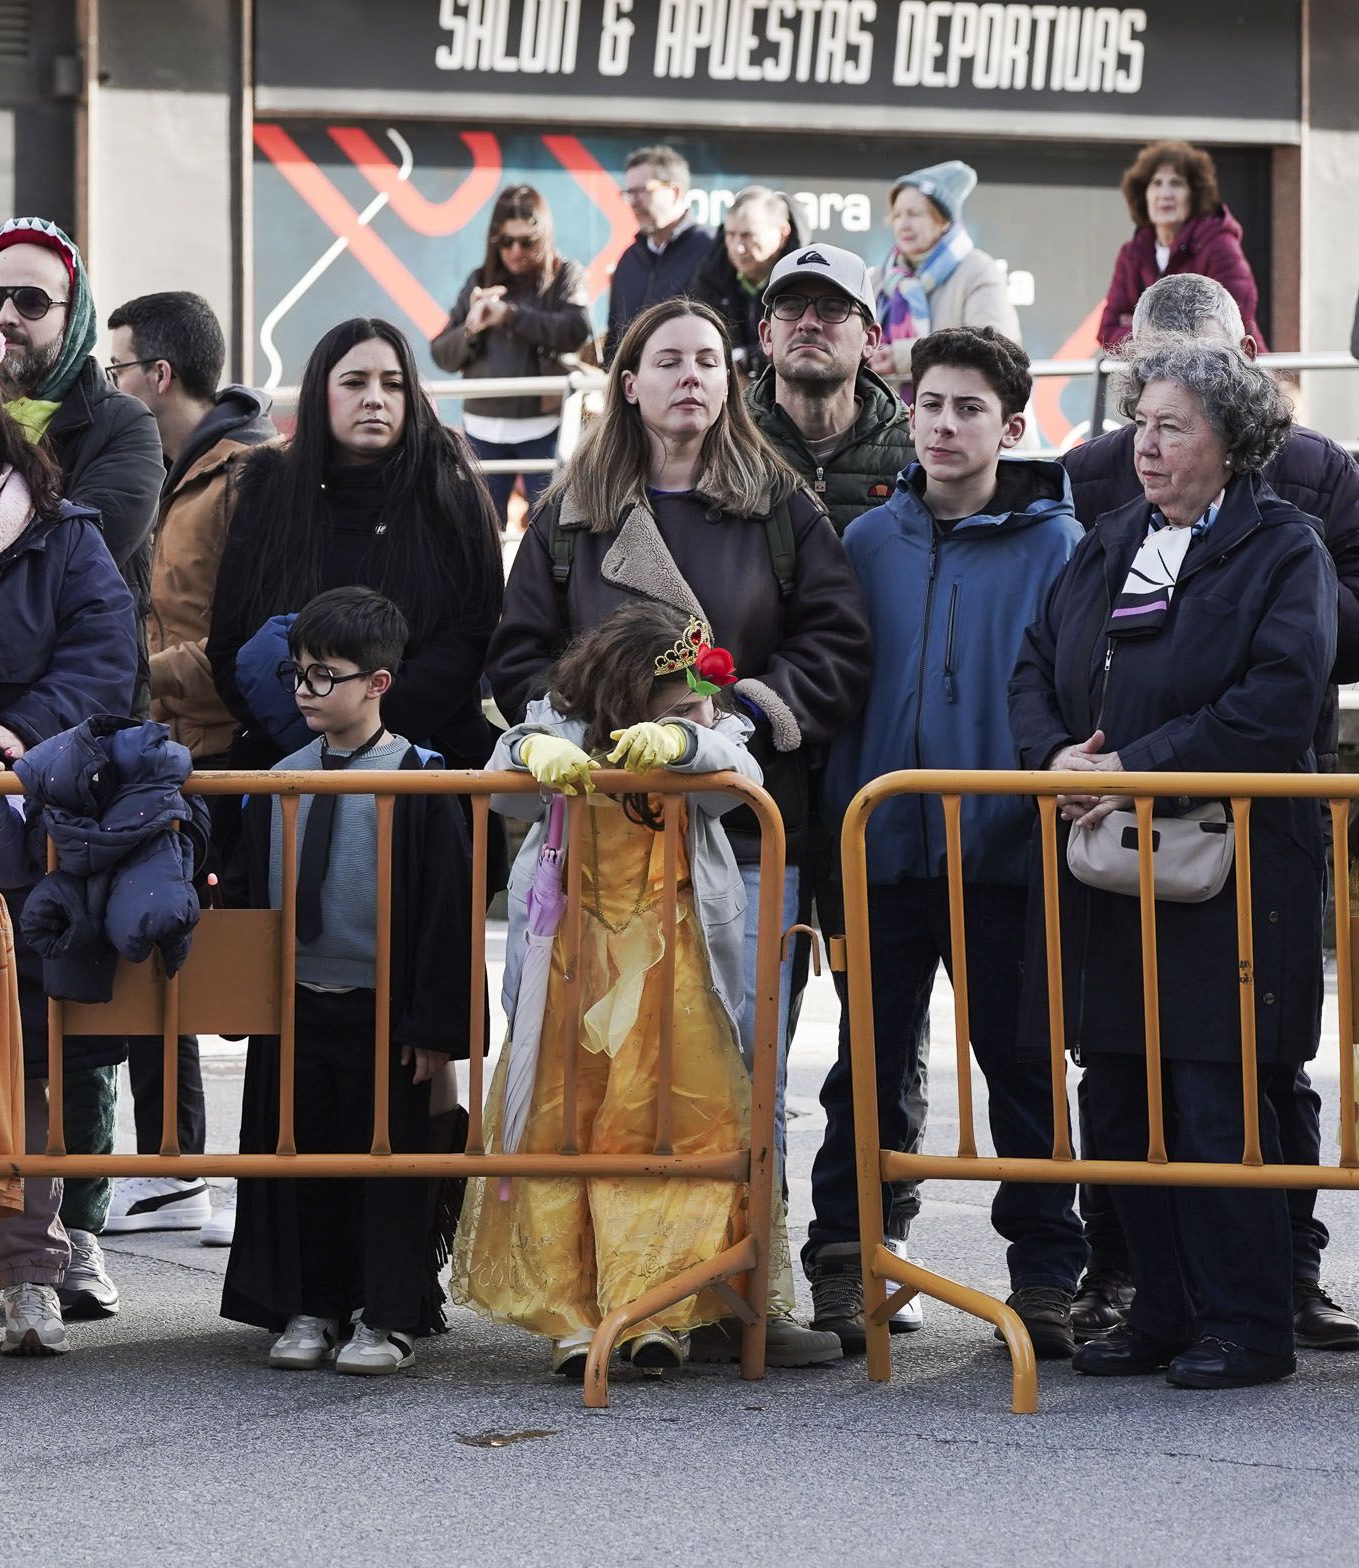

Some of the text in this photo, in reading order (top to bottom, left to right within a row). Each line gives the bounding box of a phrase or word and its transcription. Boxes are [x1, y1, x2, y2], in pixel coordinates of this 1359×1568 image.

[599, 0, 635, 76] &
[654, 0, 877, 84] APUESTAS
[893, 0, 1147, 93] DEPORTIVAS
